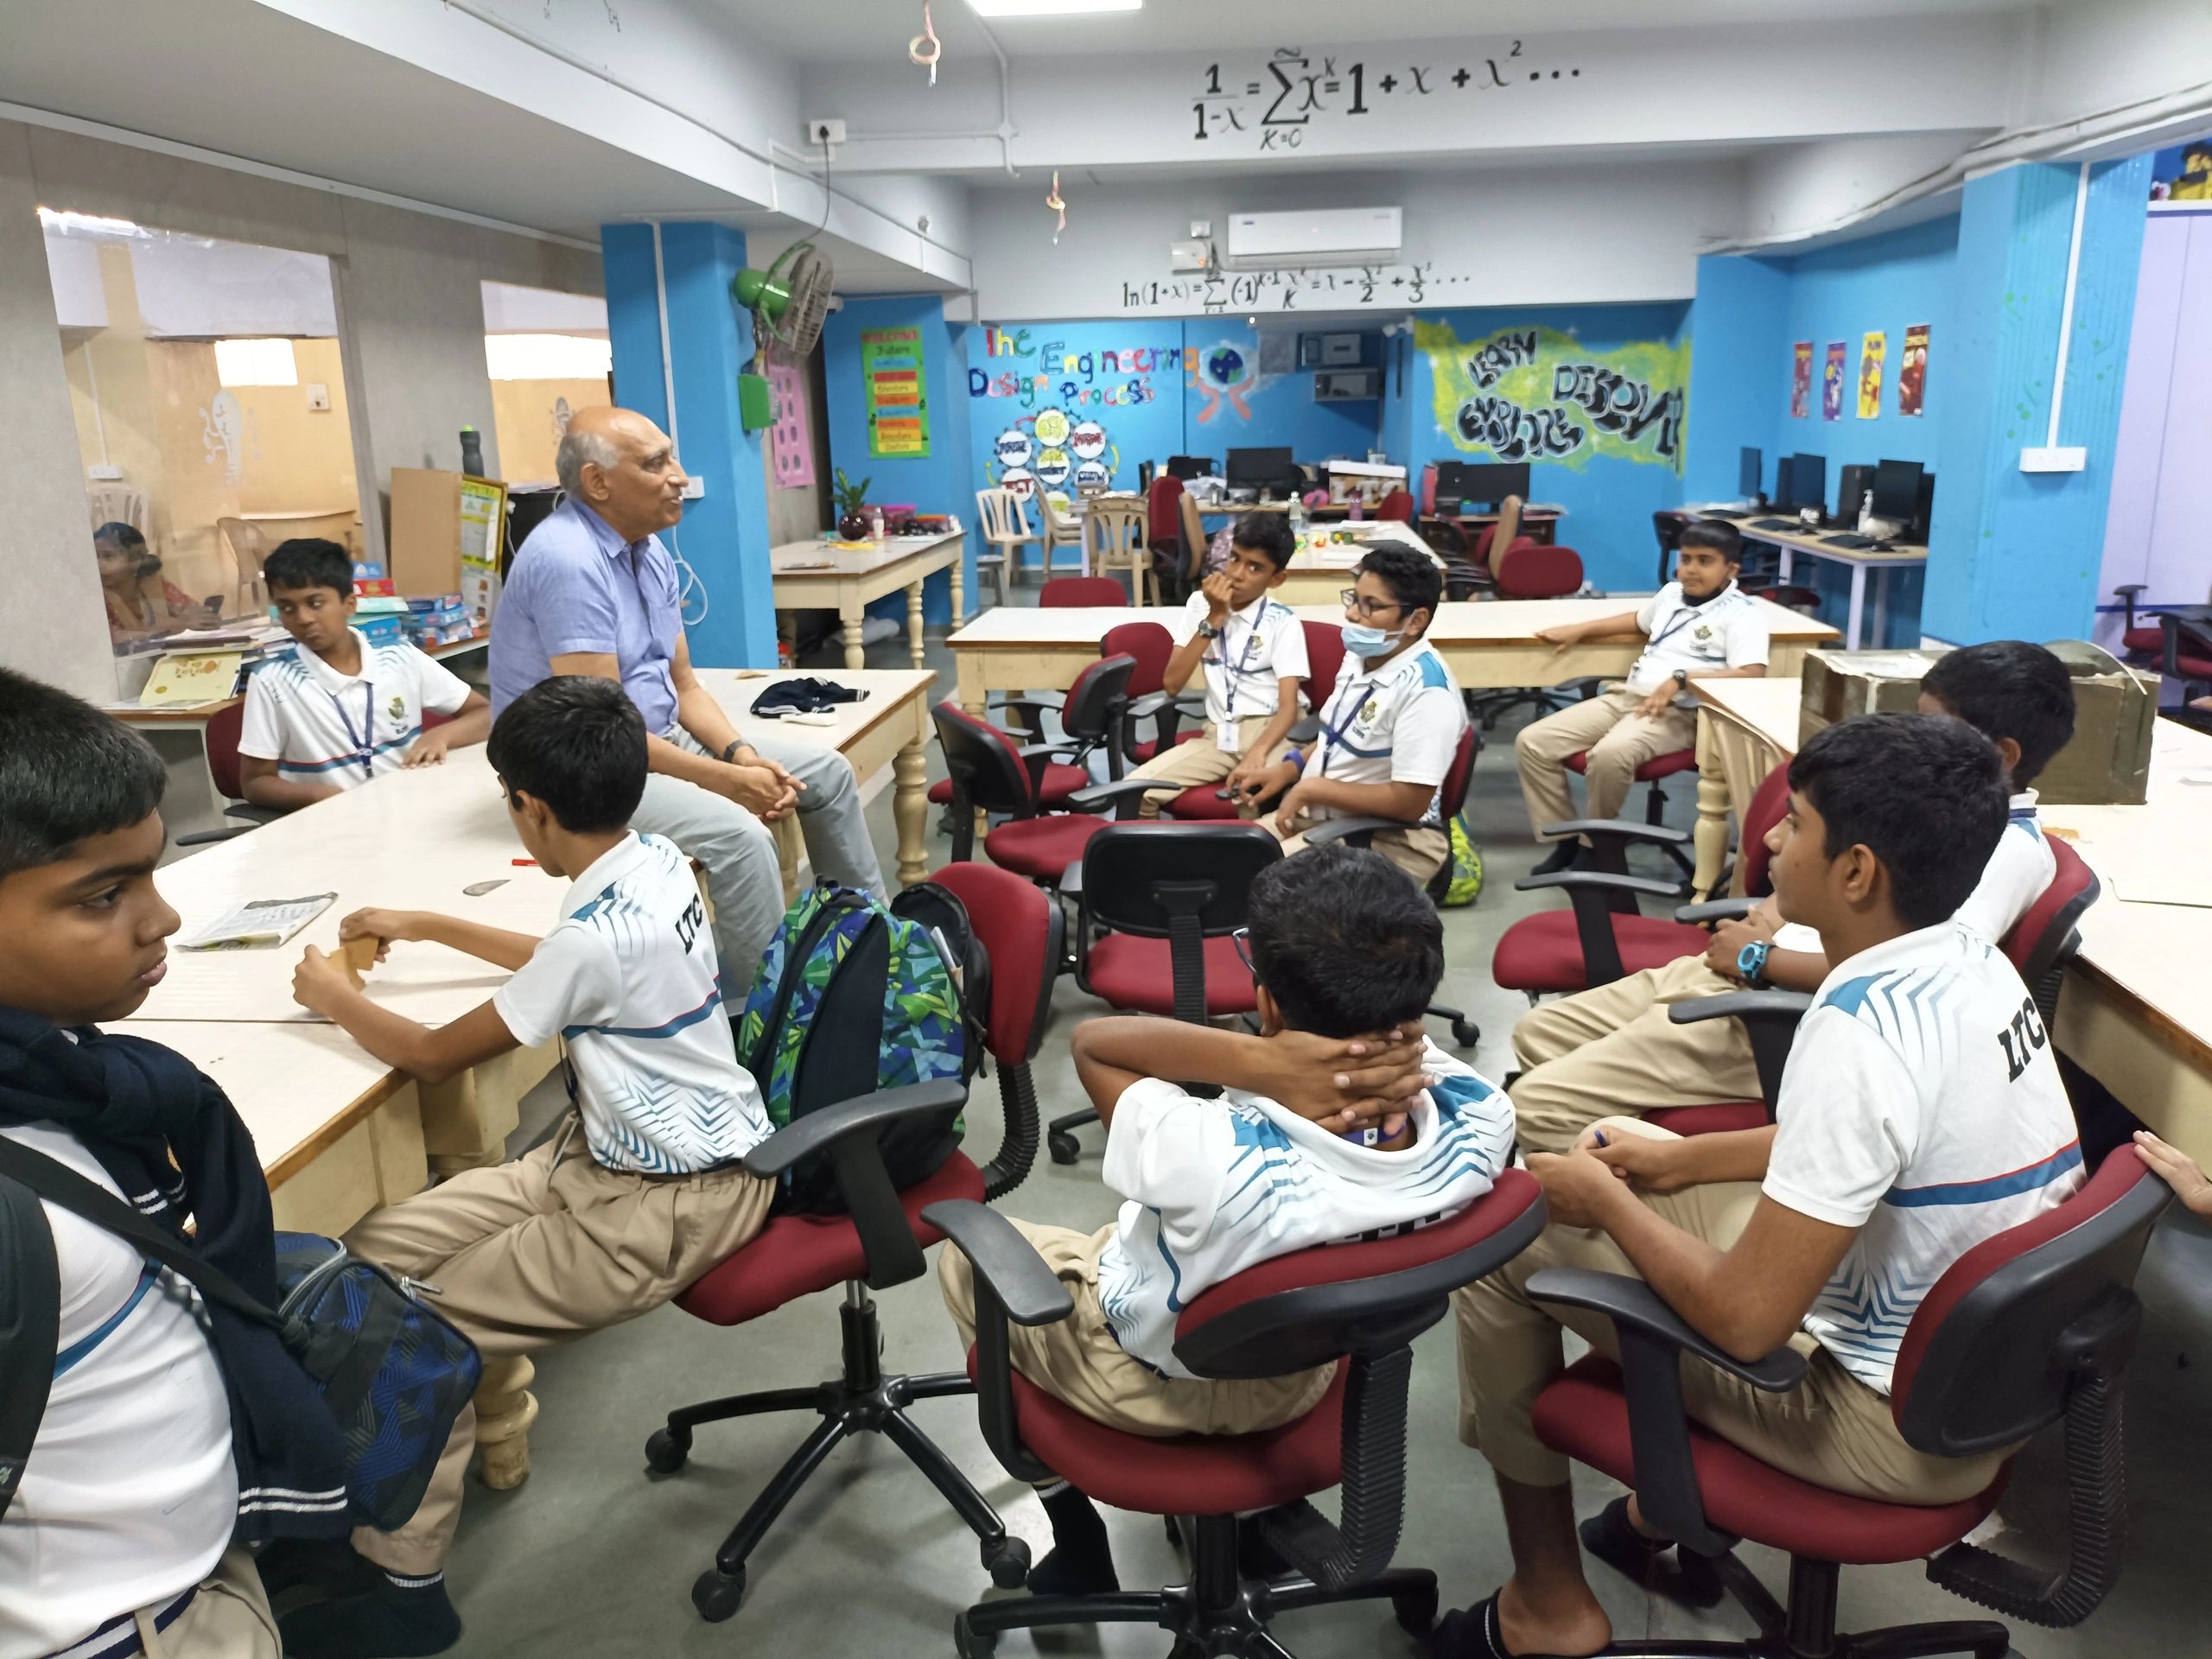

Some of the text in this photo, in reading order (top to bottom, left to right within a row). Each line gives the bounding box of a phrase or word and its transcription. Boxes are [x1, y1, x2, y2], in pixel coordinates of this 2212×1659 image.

[968, 368, 1049, 410] Design
[1039, 340, 1200, 388] Engineering
[675, 892, 703, 956] LTC
[1996, 995, 2046, 1084] LTC
